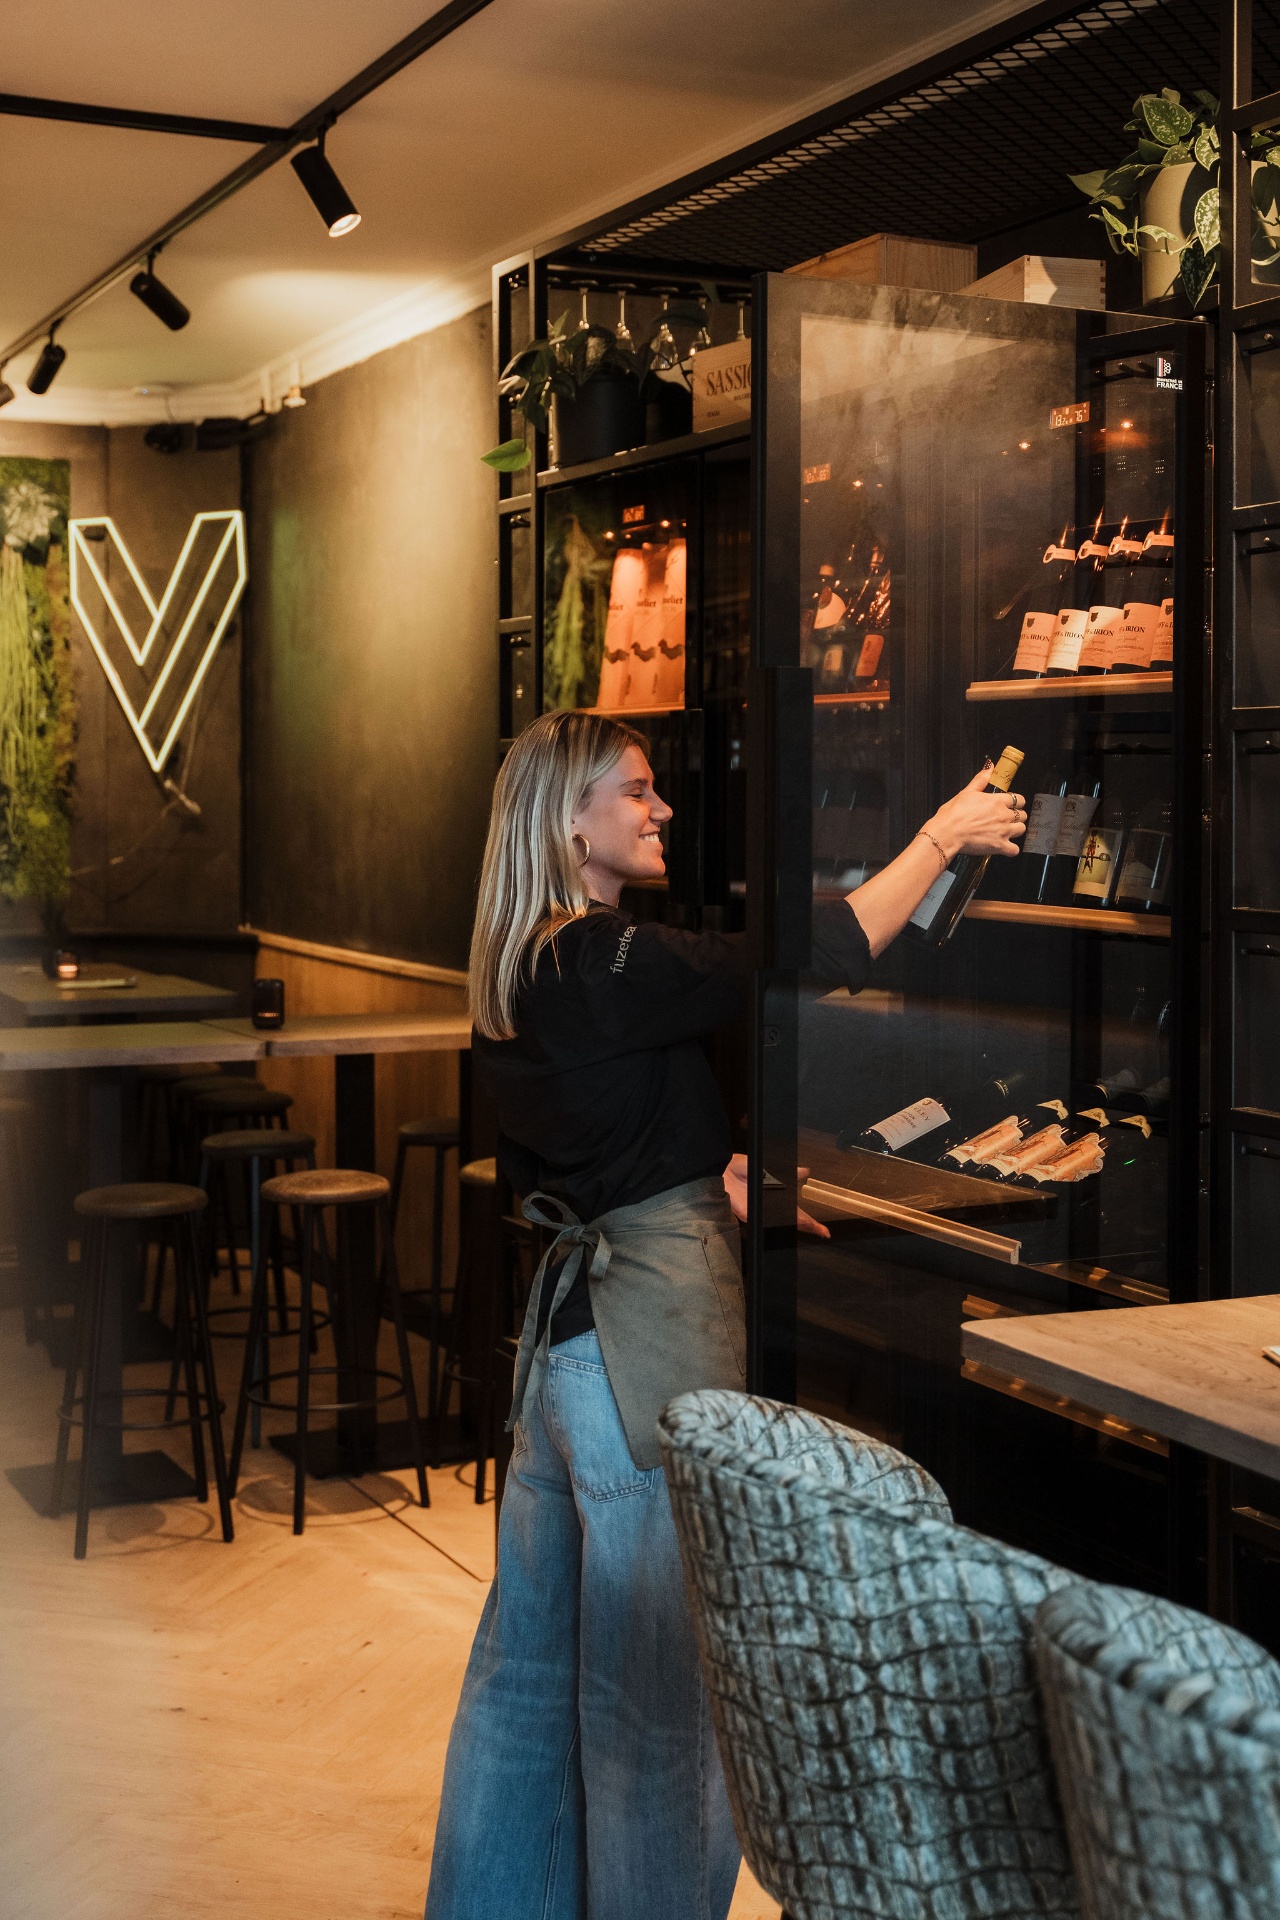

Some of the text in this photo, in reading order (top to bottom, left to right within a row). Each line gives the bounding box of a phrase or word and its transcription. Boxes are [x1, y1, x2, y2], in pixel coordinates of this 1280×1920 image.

[1156, 381, 1183, 390] FRANCE
[1093, 628, 1115, 637] IRION
[1125, 625, 1146, 633] IRION
[1030, 633, 1051, 643] IRION
[1064, 630, 1085, 640] IRION
[609, 925, 638, 974] fuzetea
